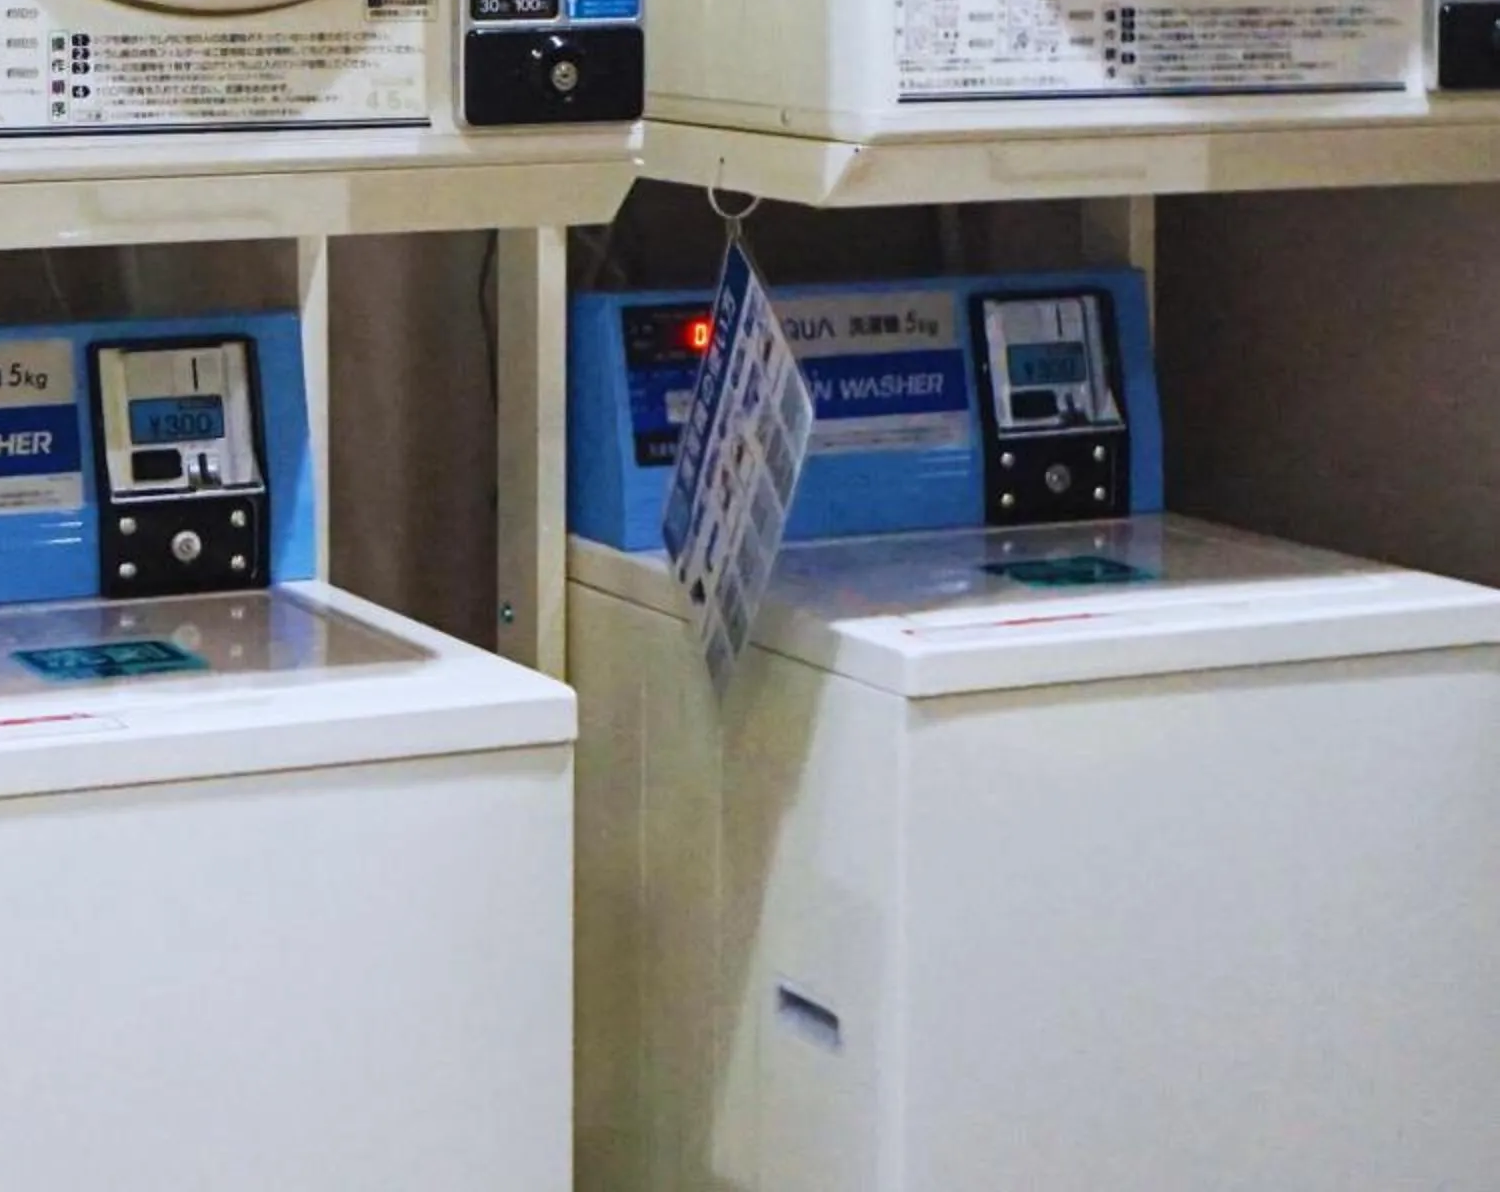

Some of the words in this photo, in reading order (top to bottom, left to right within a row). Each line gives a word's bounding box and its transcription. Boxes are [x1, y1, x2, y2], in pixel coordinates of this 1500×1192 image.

[694, 323, 708, 345] 0
[781, 316, 836, 341] QUA
[8, 363, 48, 389] 5kg
[839, 372, 945, 401] WASHER
